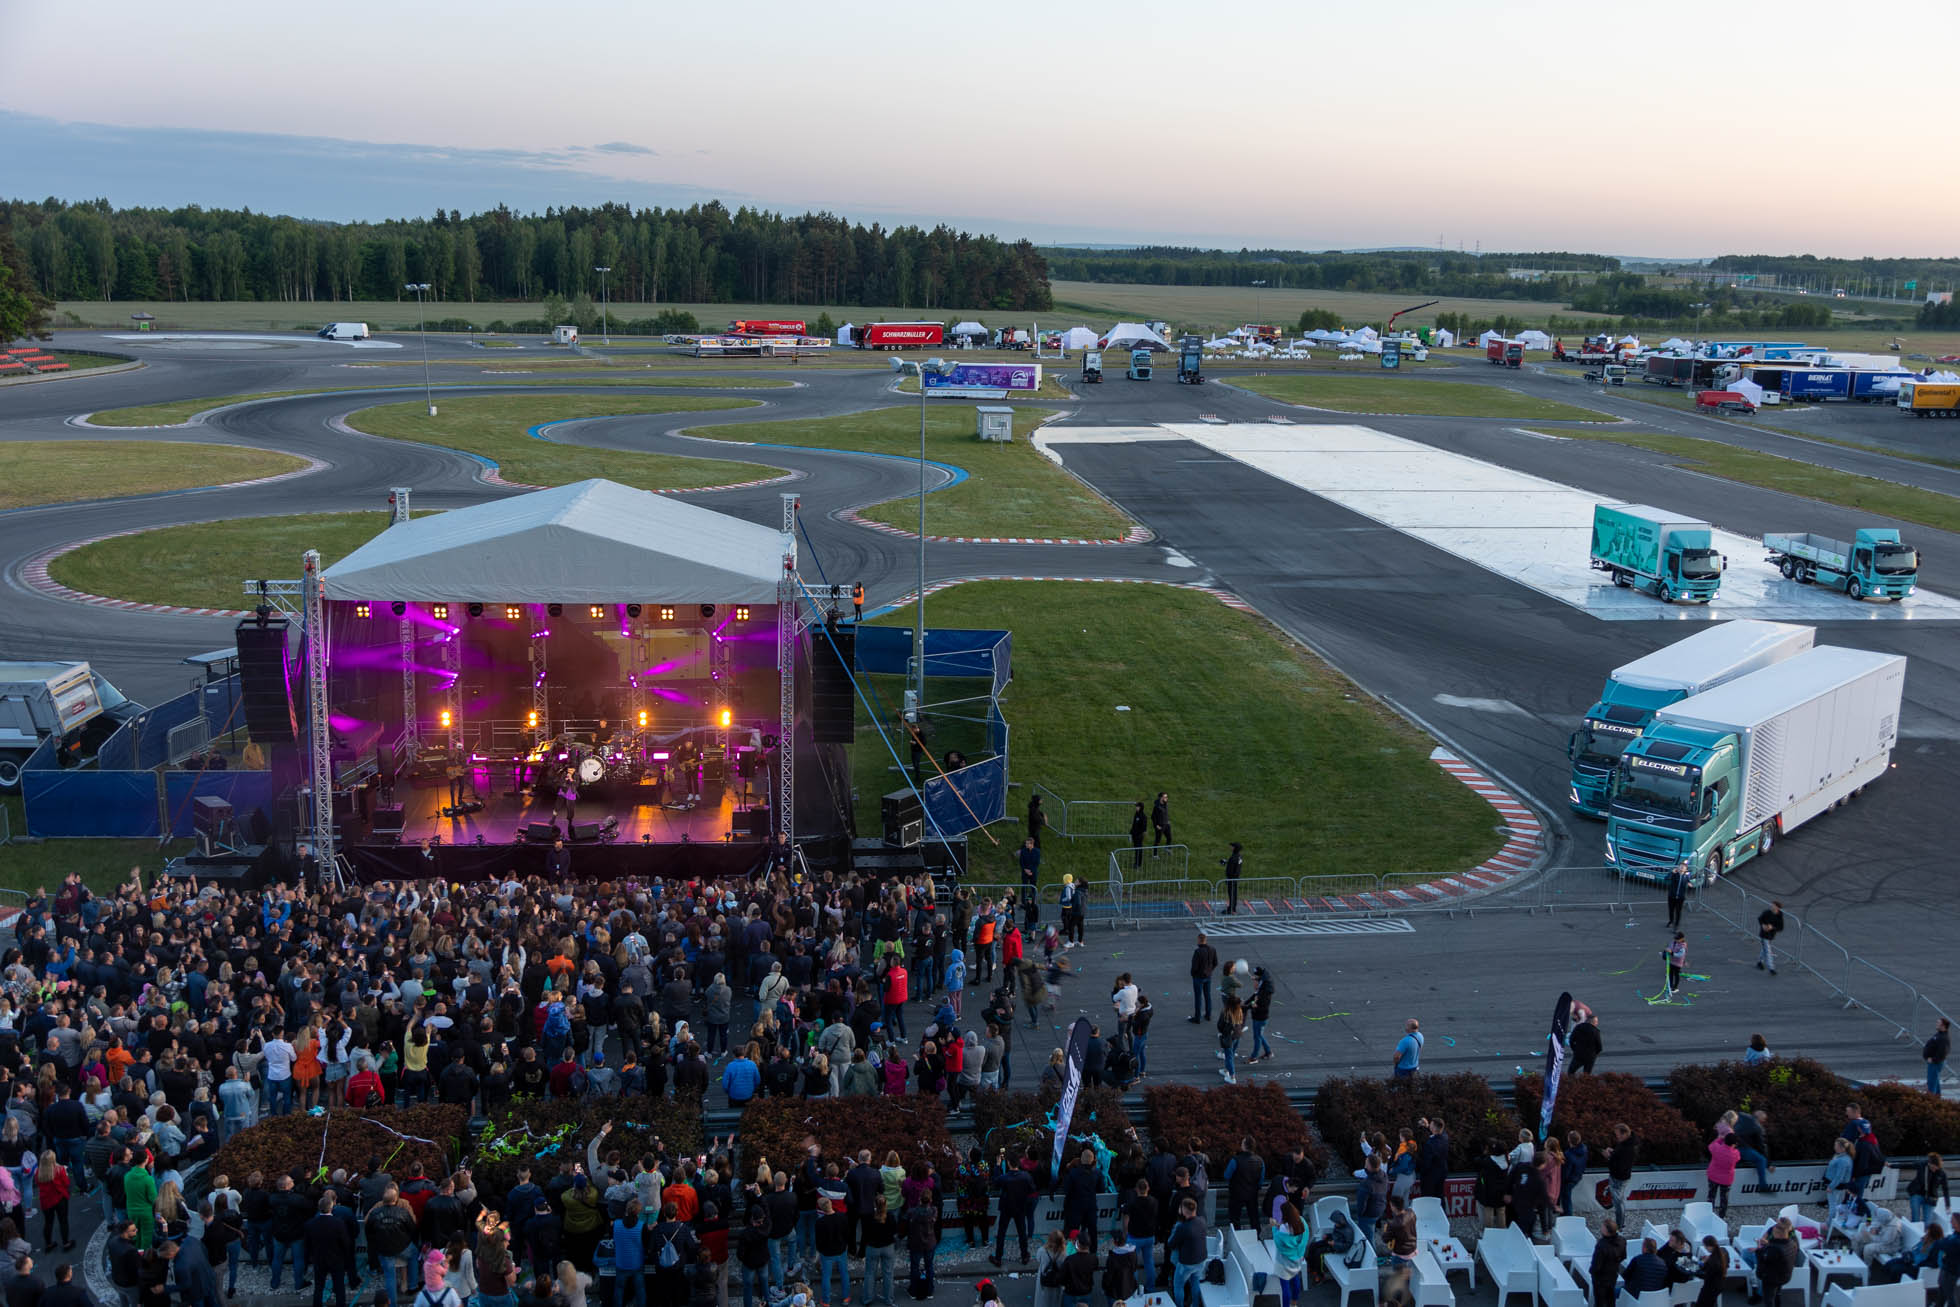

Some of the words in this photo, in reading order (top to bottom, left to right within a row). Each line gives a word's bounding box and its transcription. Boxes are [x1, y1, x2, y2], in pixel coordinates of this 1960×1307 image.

[1599, 723, 1636, 734] ELECTRIC
[1638, 760, 1680, 772] ELECTRIC
[1459, 1183, 1475, 1194] PIĘ
[1741, 1176, 1885, 1196] ww.torjas.pl
